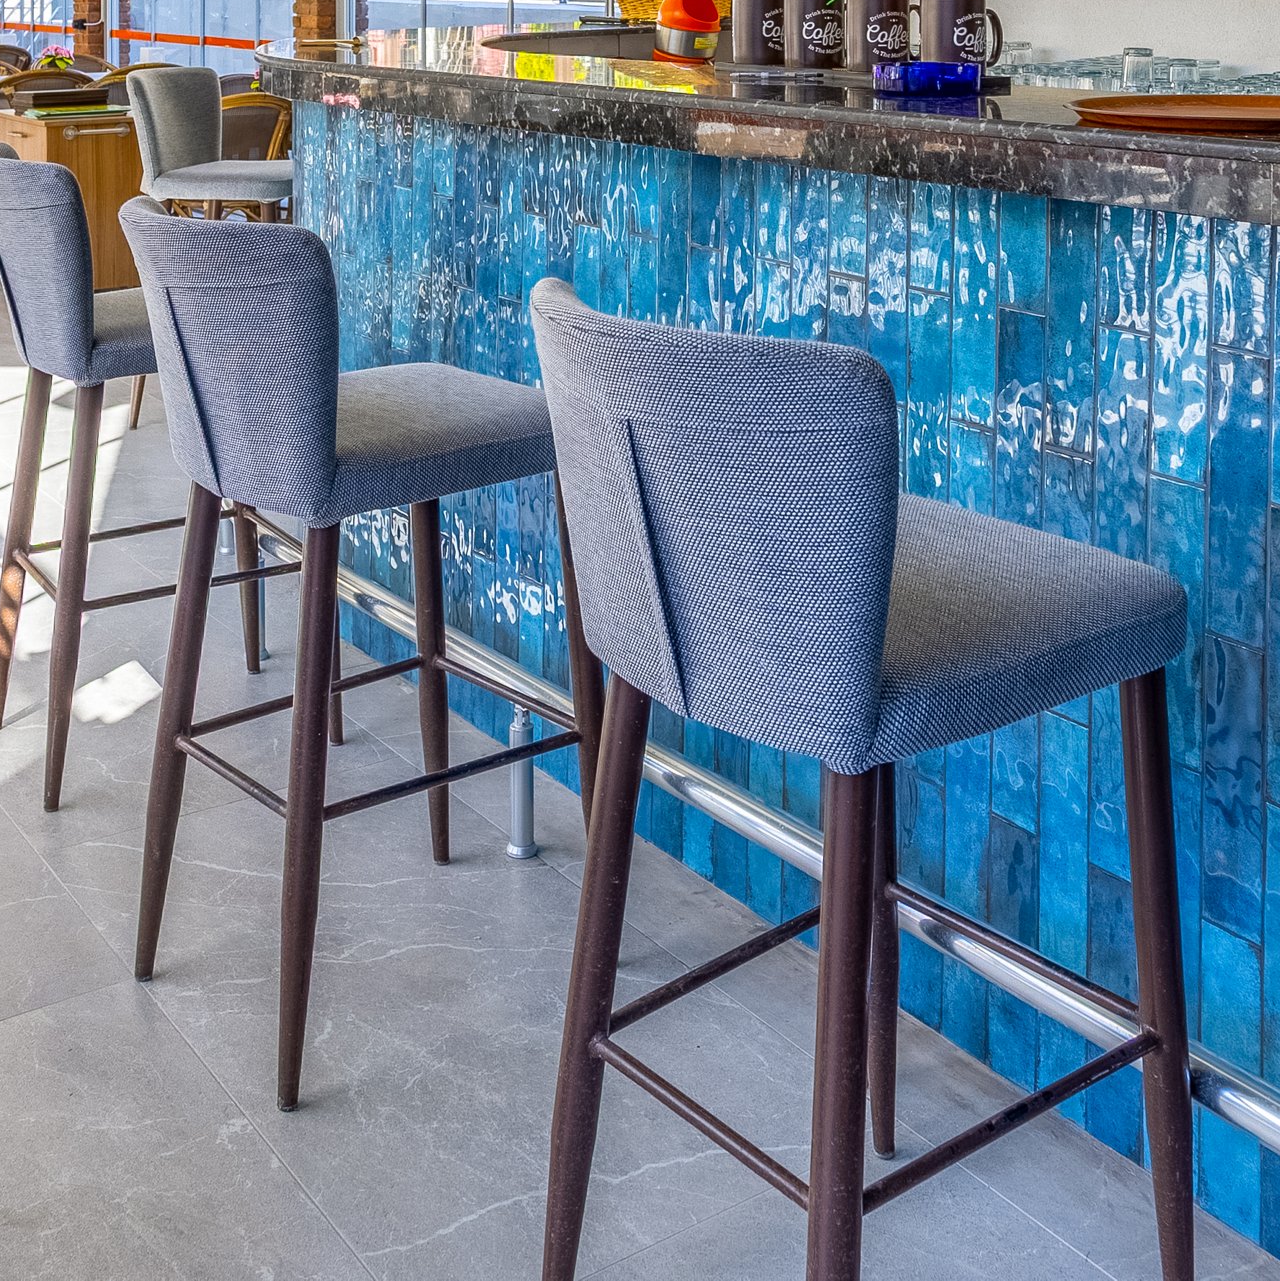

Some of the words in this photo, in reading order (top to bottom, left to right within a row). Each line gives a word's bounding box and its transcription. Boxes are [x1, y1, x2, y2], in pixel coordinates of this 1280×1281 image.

[804, 10, 821, 20] Drink
[869, 11, 886, 23] Drink
[886, 10, 900, 18] Some
[956, 13, 973, 25] Drink
